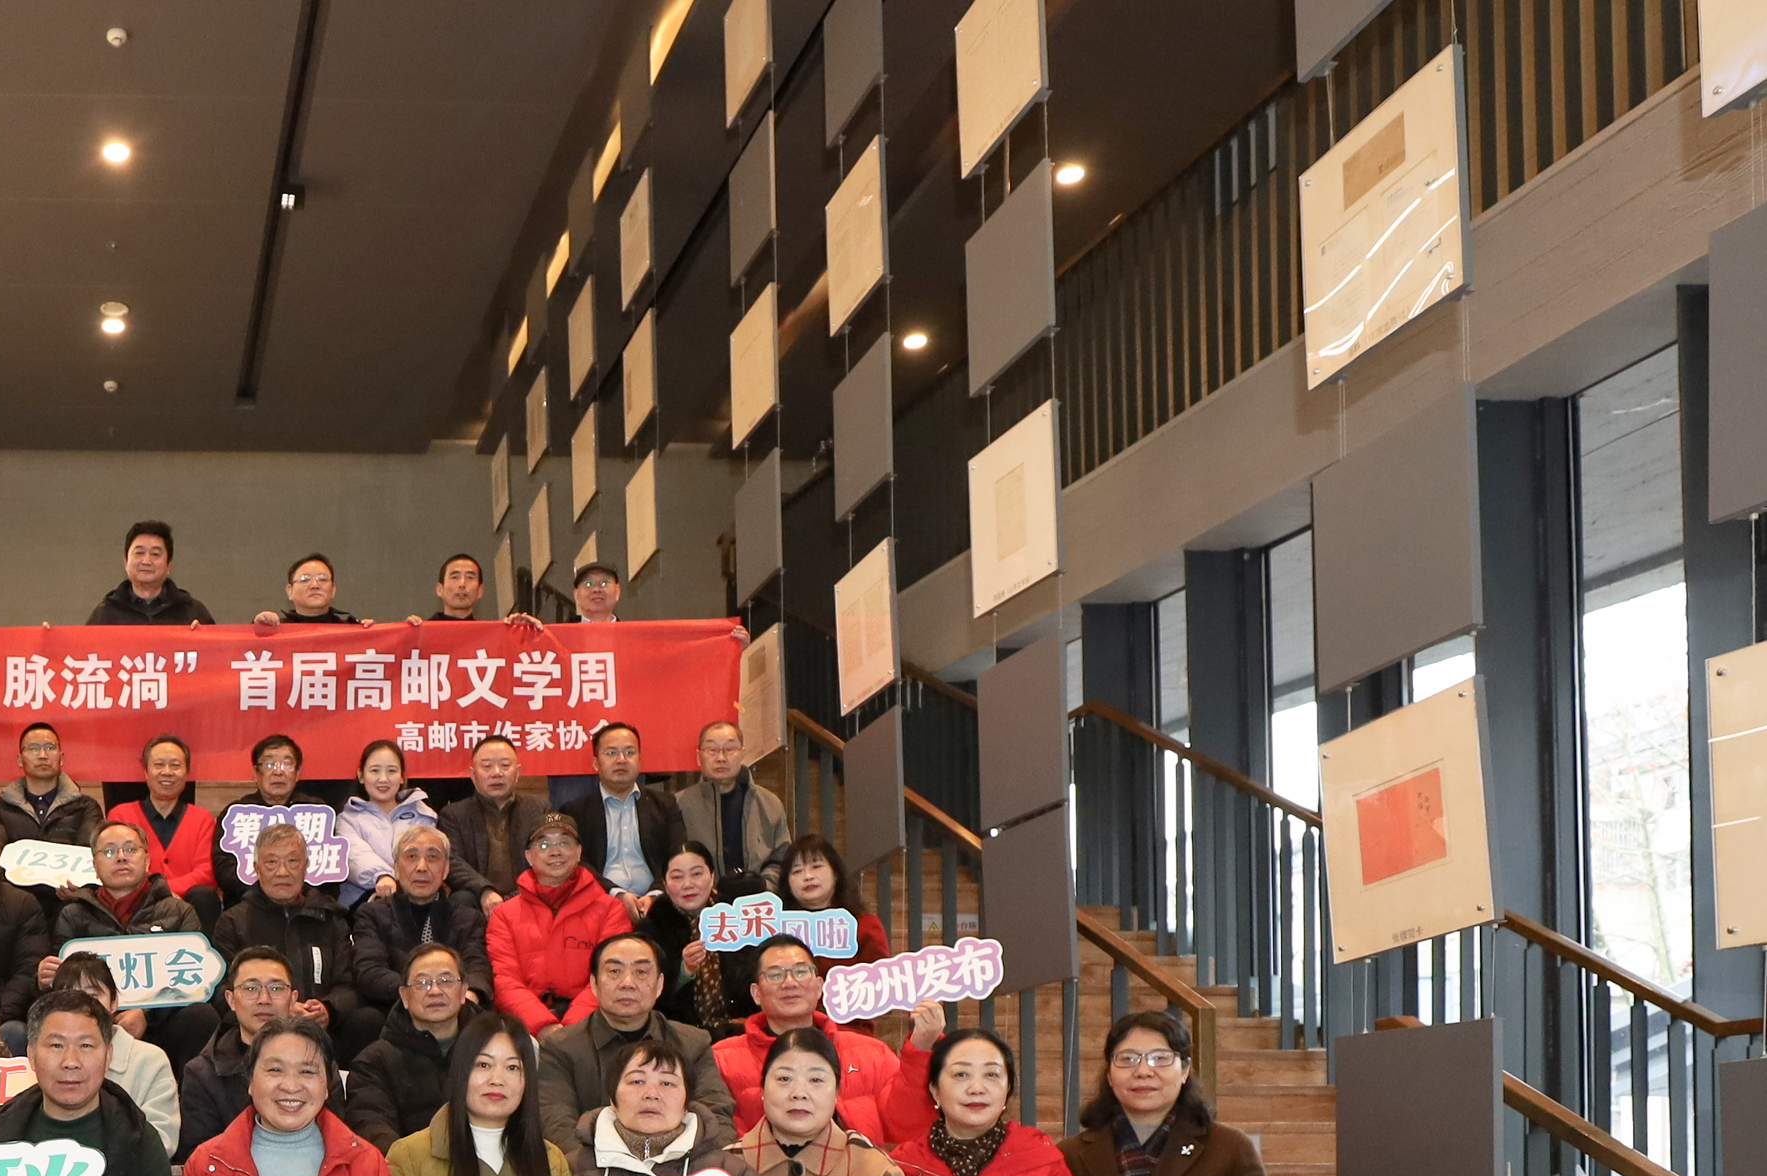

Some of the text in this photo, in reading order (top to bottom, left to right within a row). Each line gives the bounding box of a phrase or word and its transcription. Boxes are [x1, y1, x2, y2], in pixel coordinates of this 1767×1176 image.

[231, 650, 619, 711] 首届高邮文学周
[97, 948, 205, 991] 灯会
[831, 943, 996, 1016] 扬州发布
